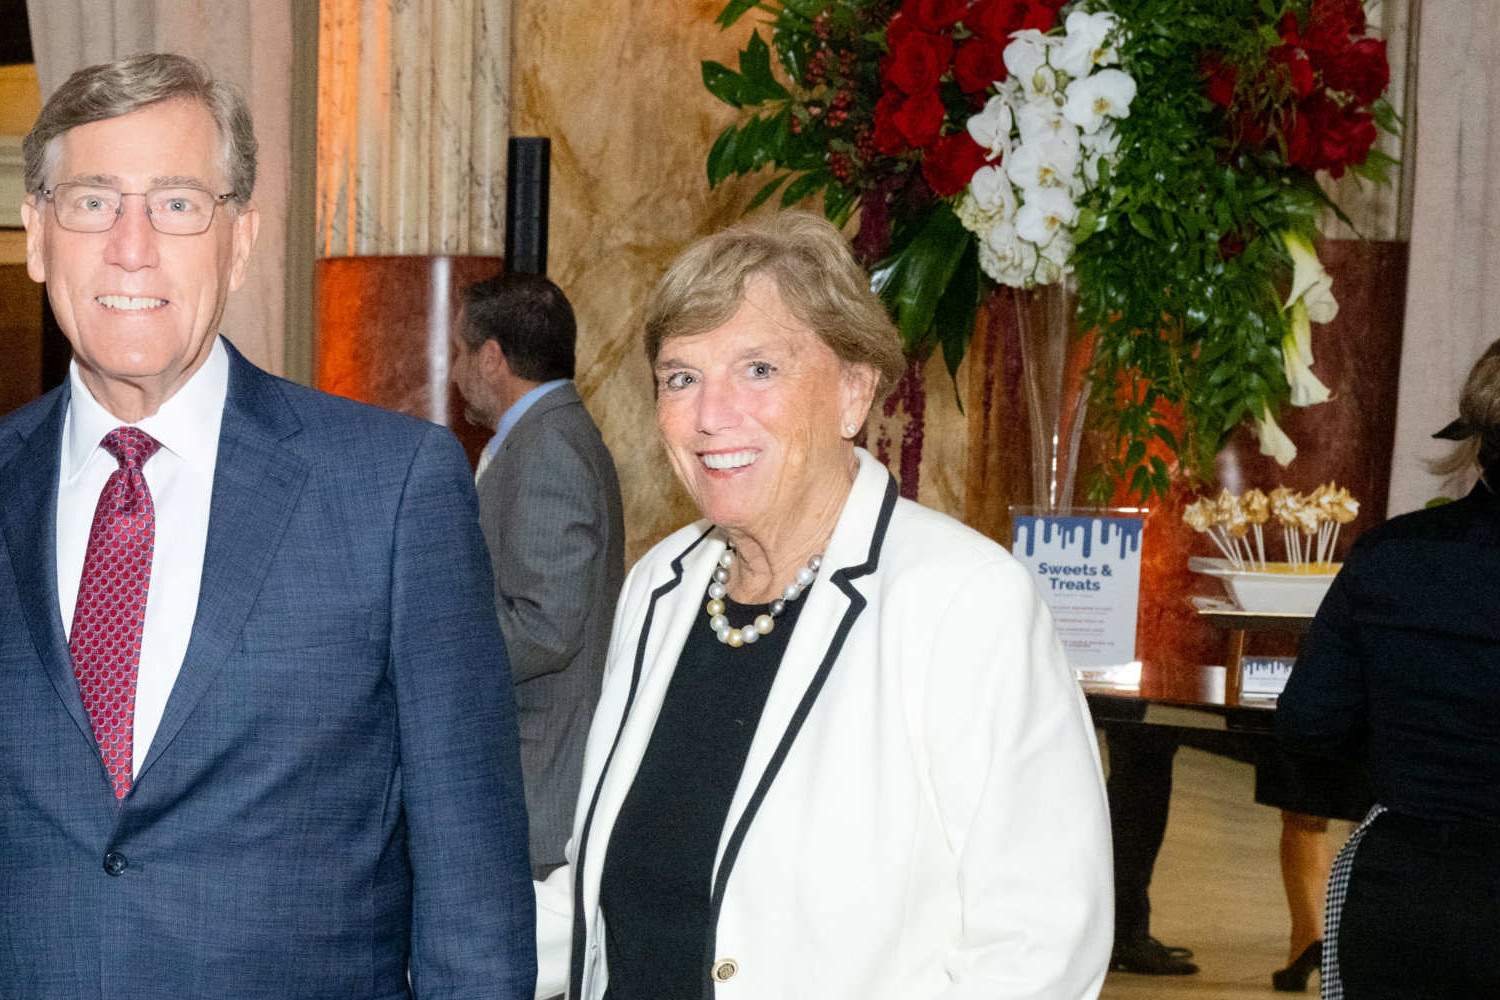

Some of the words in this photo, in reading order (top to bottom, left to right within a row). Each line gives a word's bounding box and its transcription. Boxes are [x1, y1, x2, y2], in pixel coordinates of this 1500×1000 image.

[1038, 562, 1097, 576] Sweets
[1101, 564, 1113, 576] &
[1049, 577, 1101, 591] Treats
